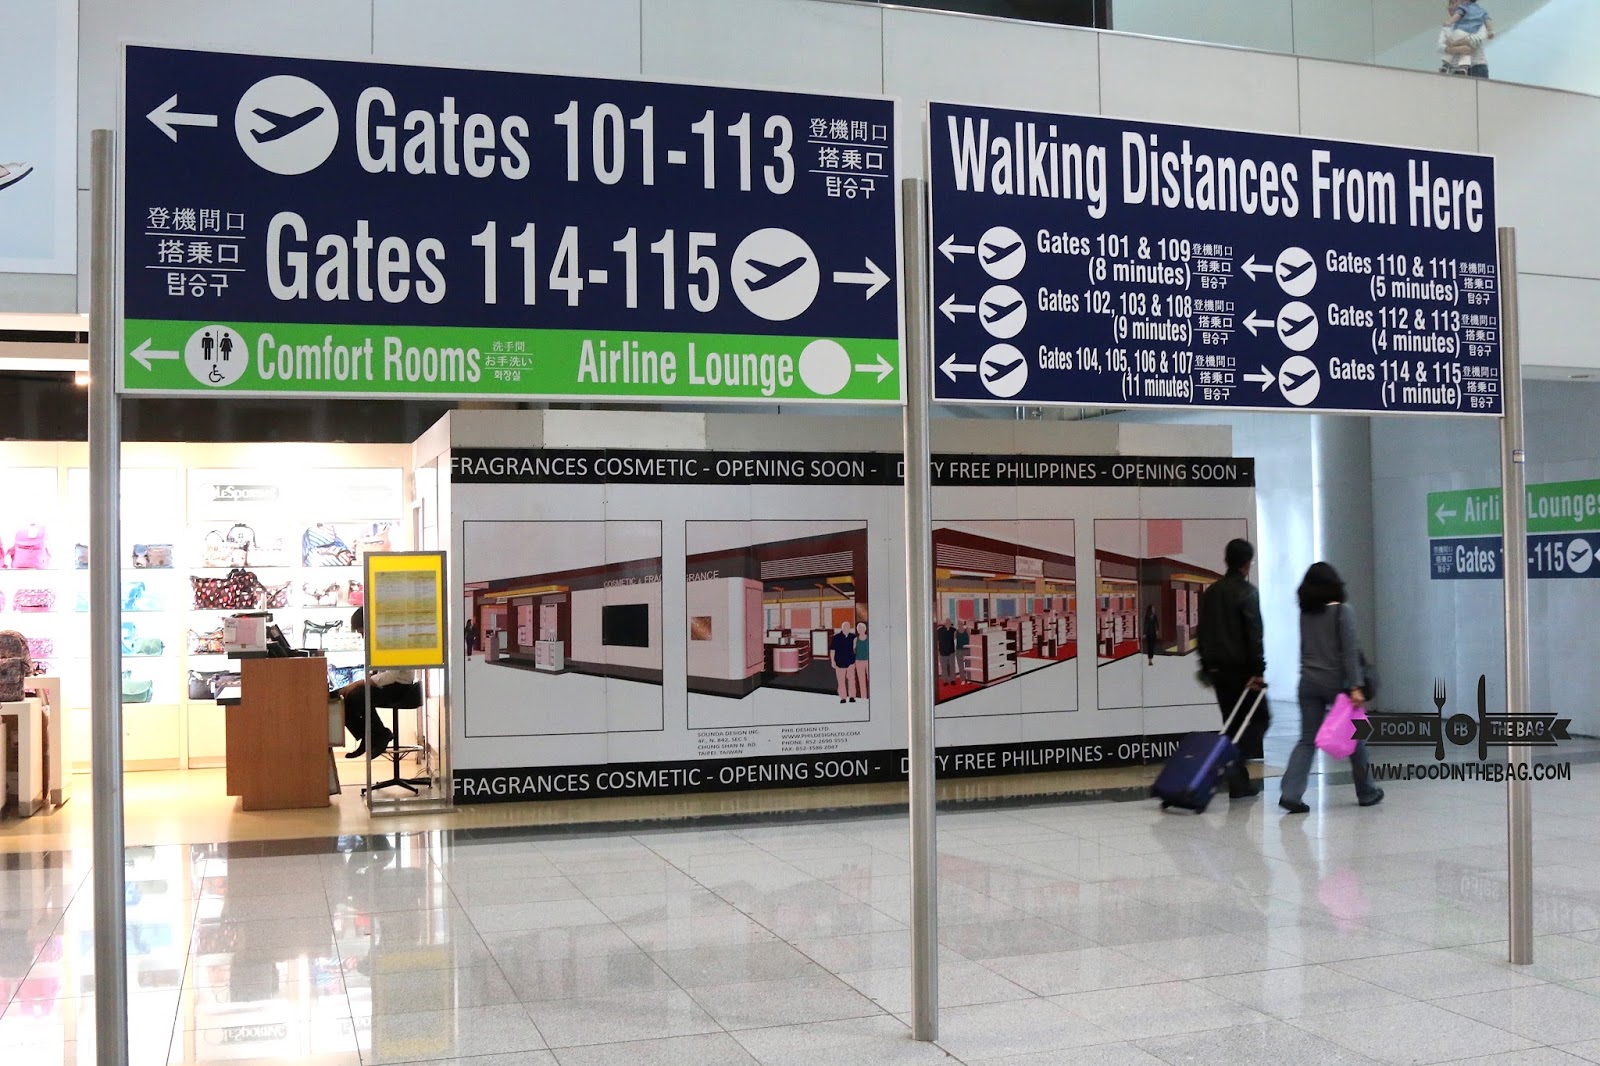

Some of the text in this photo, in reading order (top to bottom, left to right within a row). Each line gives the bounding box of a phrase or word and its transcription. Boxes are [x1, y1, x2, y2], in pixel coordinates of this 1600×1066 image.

[356, 86, 795, 195] Gates 101-113
[809, 117, 887, 142] 登機間口
[818, 147, 883, 170] 搭乗口
[947, 115, 1483, 233] Walking Distances From Here
[826, 176, 876, 199] 탑승구
[147, 207, 244, 232] 登機間口
[158, 239, 239, 264] 搭乗口
[1037, 229, 1191, 263] Gates 101 & 109
[265, 211, 720, 313] Gates 114-115
[1088, 256, 1191, 291] (8 minutes)
[1326, 249, 1457, 280] Gates 110 & 111
[167, 272, 229, 297] 탑승구
[1370, 274, 1459, 307] (5 minutes)
[1038, 287, 1192, 318] Gates 102, 103 & 108
[1327, 303, 1461, 332] Gates 112 & 113
[1113, 315, 1192, 347] (9 minutes)
[1371, 328, 1461, 359] (4 minutes)
[257, 333, 481, 382] Comfort Rooms
[484, 355, 533, 367] お手洗い
[577, 339, 794, 396] Airline Lounge
[1038, 345, 1194, 376] Gates 104, 105, 106 & 107
[1329, 357, 1462, 385] Gates 114 & 115
[1122, 372, 1194, 403] (11 minutes)
[1382, 380, 1462, 409] (1 minute)
[451, 457, 588, 476] FRAGRANCES
[594, 458, 698, 477] COSMETIC
[716, 458, 805, 478] OPENING
[811, 460, 865, 478] SOON
[897, 461, 944, 478] DY
[950, 462, 990, 479] FREE
[996, 462, 1097, 480] PHILIPPINES
[1111, 463, 1187, 481] OPENING
[1191, 464, 1238, 481] SOON
[1464, 492, 1600, 522] Airli Lounge
[1456, 545, 1496, 573] Gates
[901, 755, 949, 774] DY
[955, 752, 996, 771] FREE
[1002, 745, 1103, 768] PHILIPPINES
[1118, 740, 1180, 760] OPENIN
[453, 774, 591, 796] FRAGRANCES
[597, 768, 701, 790] COSMETIC
[720, 759, 809, 785] OPENING
[814, 759, 868, 778] SOON
